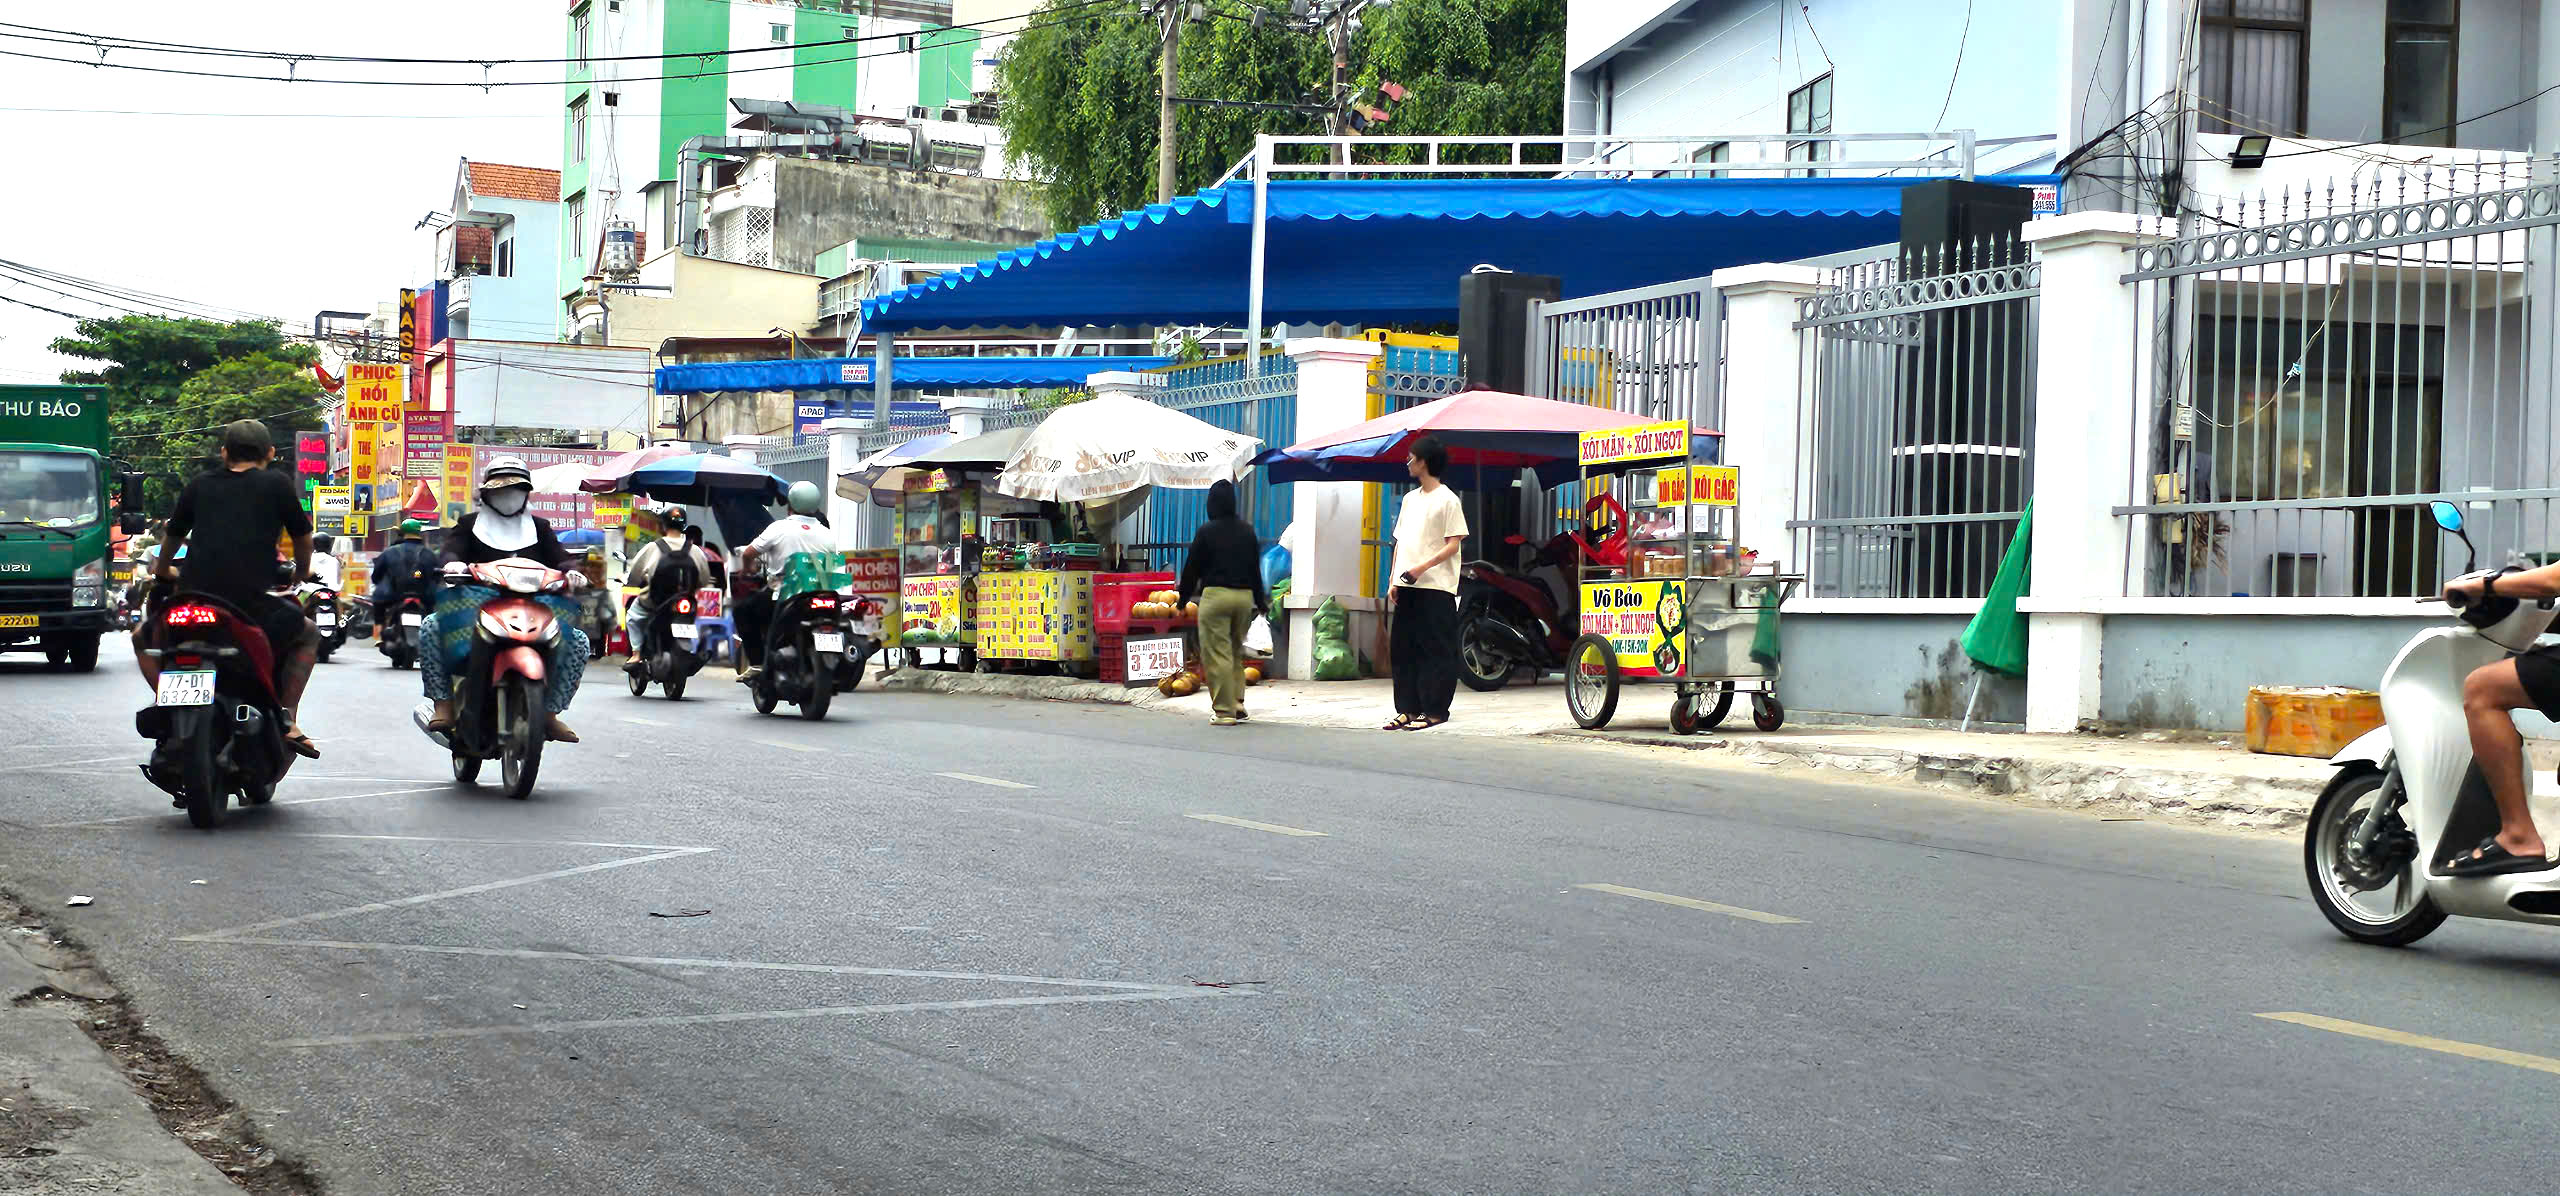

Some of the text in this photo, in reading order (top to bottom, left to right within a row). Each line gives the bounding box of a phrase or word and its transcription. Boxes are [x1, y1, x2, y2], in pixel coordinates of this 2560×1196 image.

[39, 399, 81, 416] BÁO
[381, 403, 401, 421] CŨ
[1582, 437, 1600, 460] XÔI
[1601, 433, 1625, 459] MẶN
[1634, 430, 1653, 454] XÔI
[1654, 430, 1684, 455] NGỌT
[1694, 474, 1711, 500] XÔI
[1593, 585, 1643, 608] Võ Bảo
[929, 600, 942, 618] 20k
[1148, 651, 1181, 670] 25K
